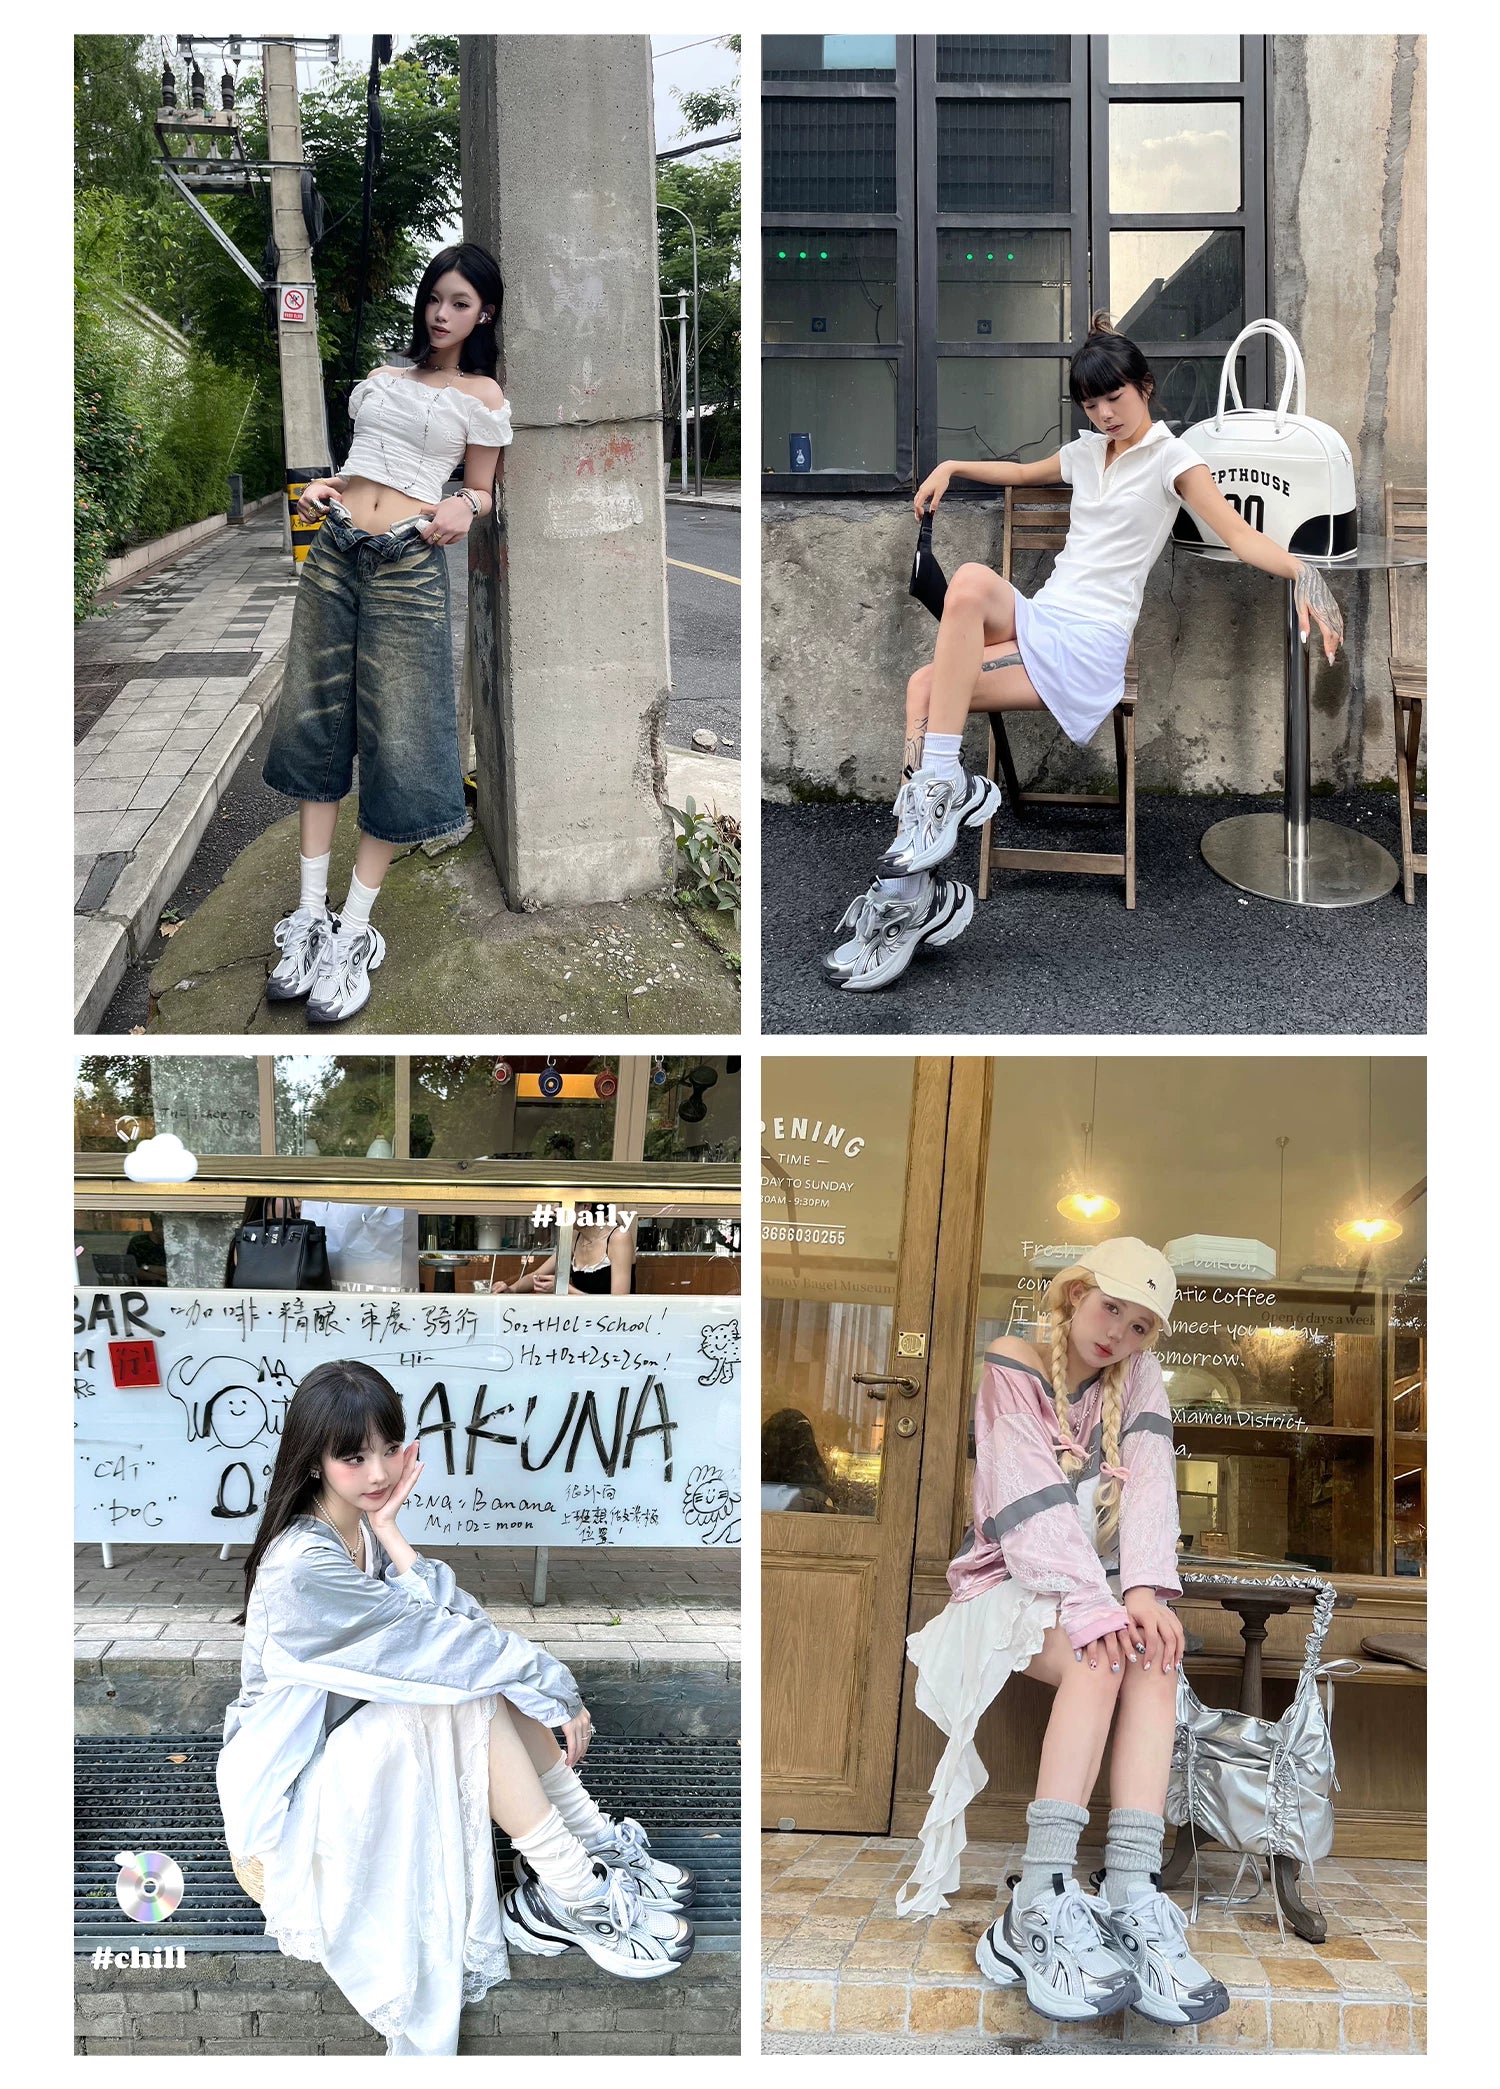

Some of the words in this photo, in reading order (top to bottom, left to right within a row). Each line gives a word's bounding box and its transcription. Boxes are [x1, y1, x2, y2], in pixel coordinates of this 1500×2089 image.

[778, 1153, 810, 1166] TIME
[787, 1177, 802, 1189] TO
[804, 1179, 855, 1193] SUNDAY
[794, 1197, 830, 1208] 9:30PM
[762, 1226, 846, 1245] 3666030255
[1021, 1240, 1076, 1260] Fresh
[803, 1278, 838, 1293] Bagel
[840, 1279, 896, 1295] Museum
[1212, 1287, 1277, 1307] Coffee
[1261, 1310, 1294, 1324] Open
[1307, 1312, 1337, 1327] days
[1337, 1315, 1344, 1325] a
[1172, 1320, 1222, 1336] meet
[1227, 1324, 1258, 1340] you
[397, 1374, 679, 1483] AKUNA
[1172, 1407, 1232, 1426] Xiamen
[1236, 1411, 1310, 1433] District,
